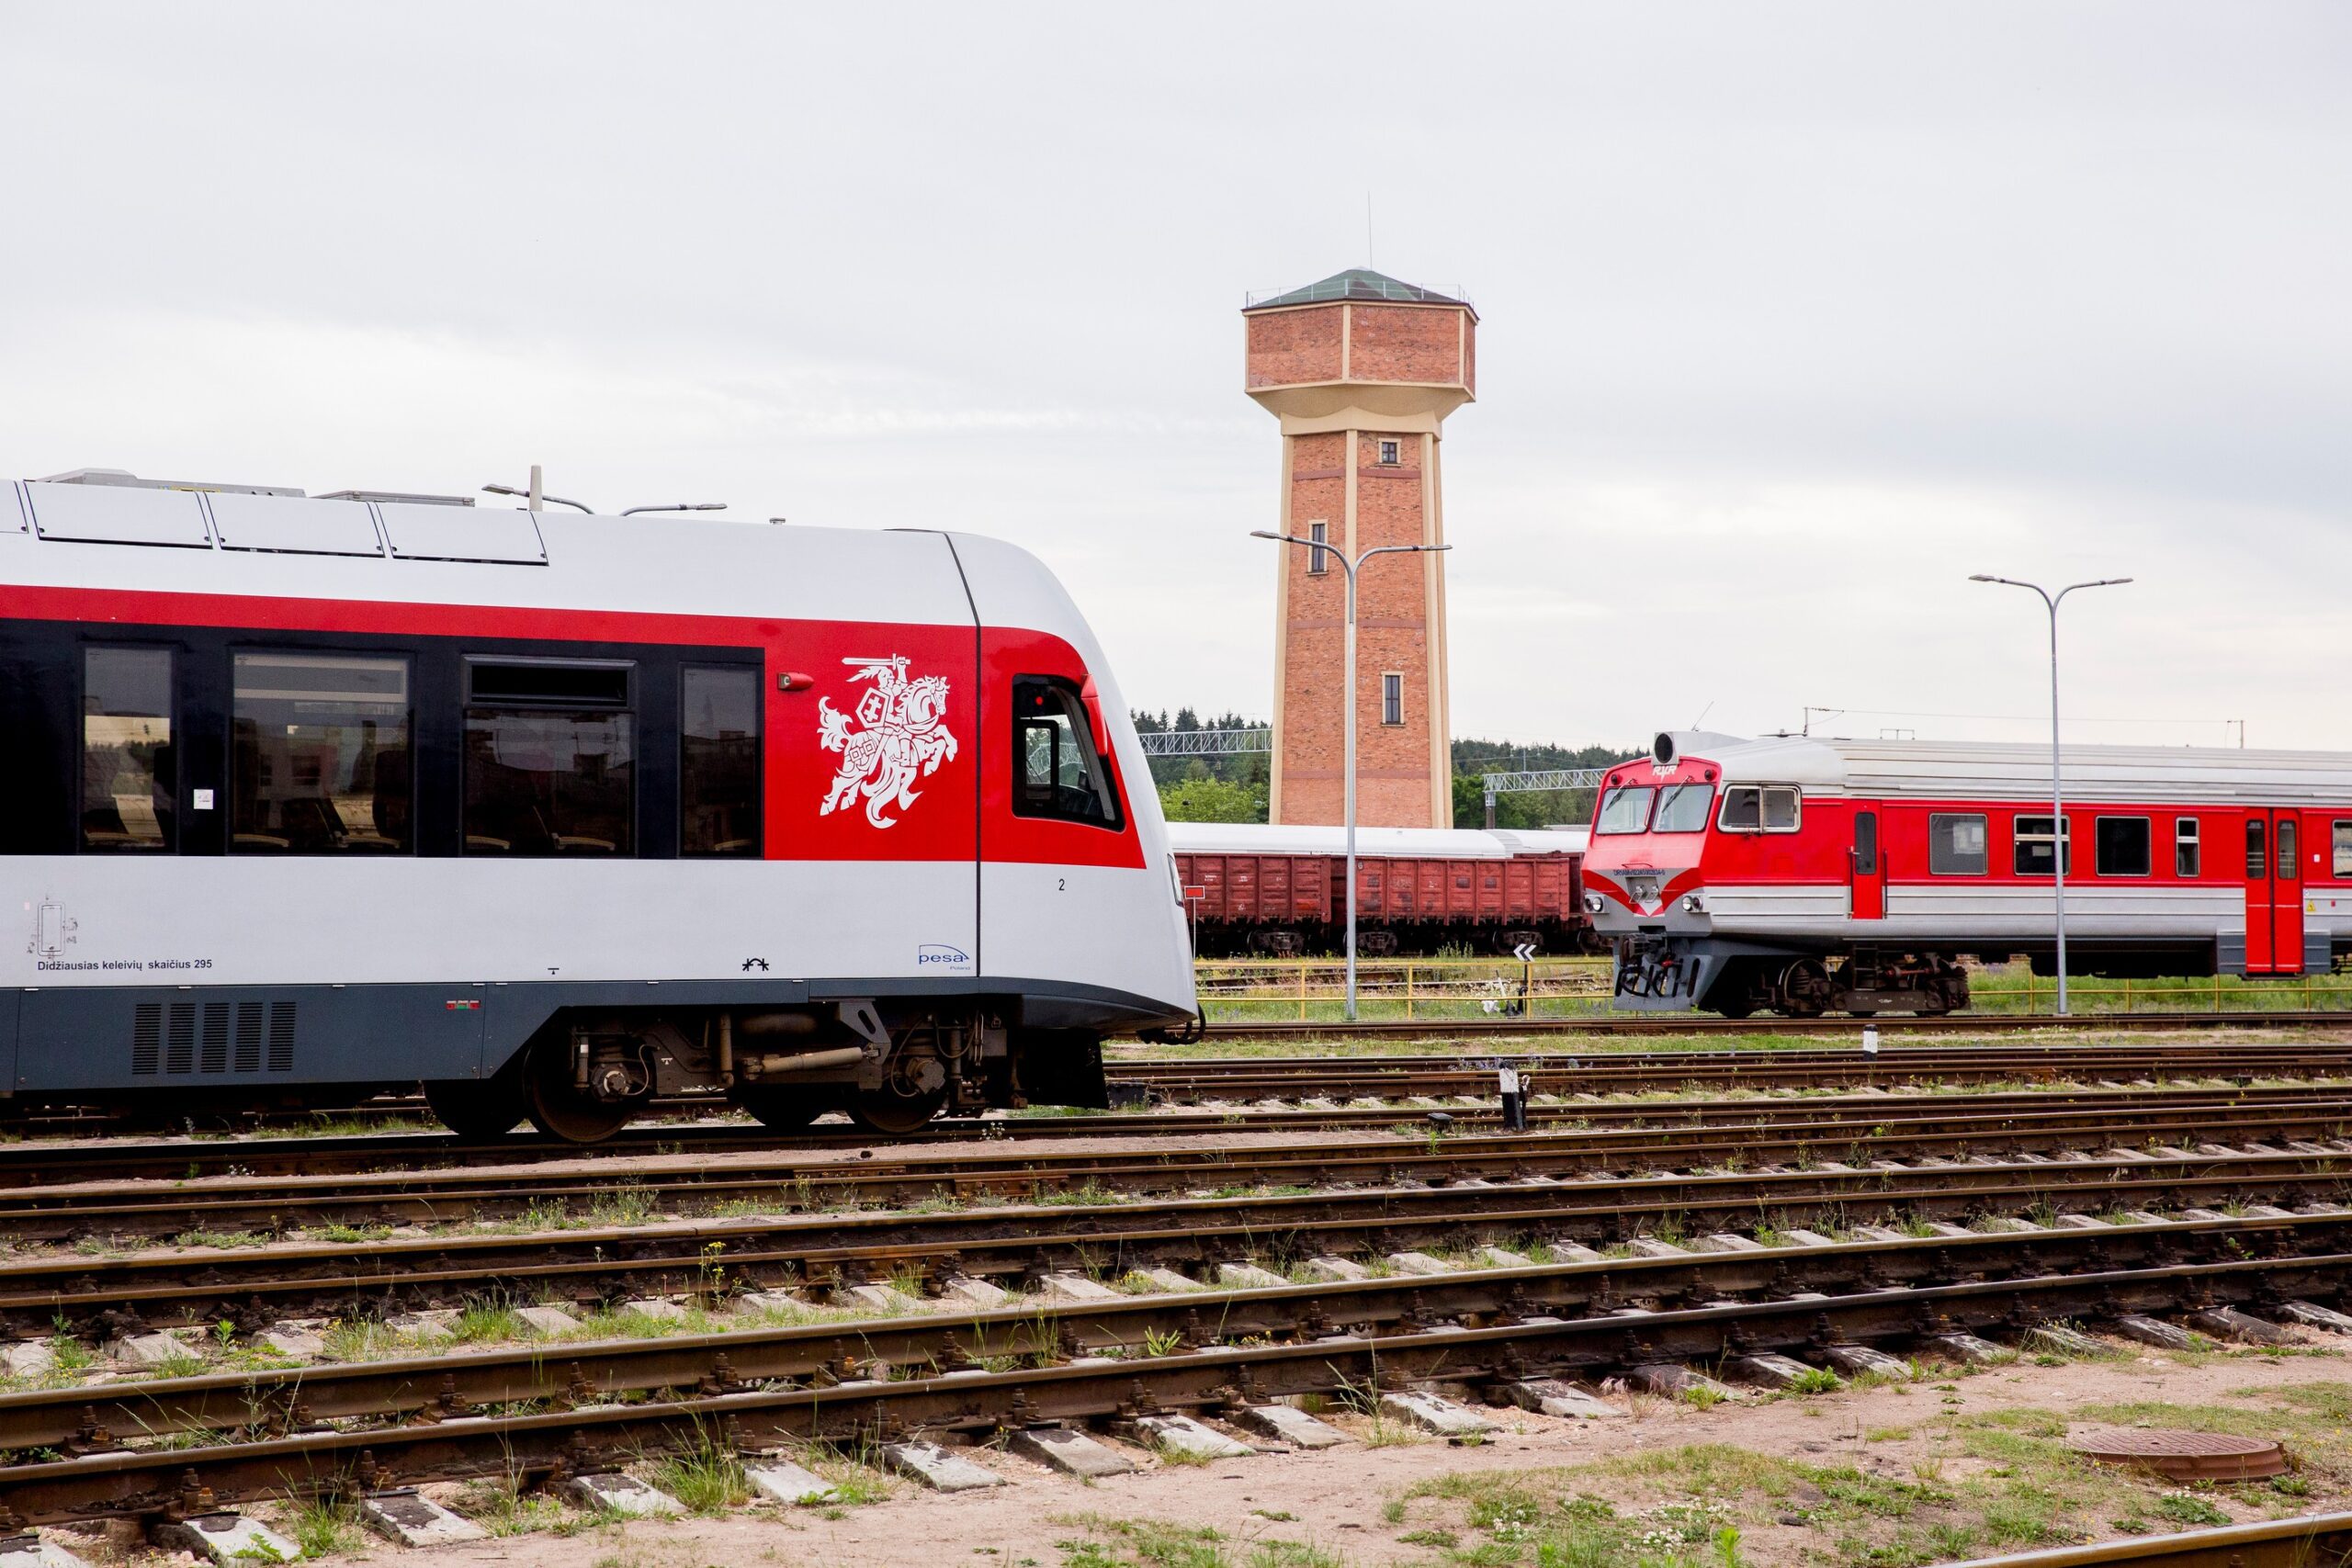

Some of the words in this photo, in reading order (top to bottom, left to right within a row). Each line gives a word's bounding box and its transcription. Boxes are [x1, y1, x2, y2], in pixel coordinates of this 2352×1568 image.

[1058, 878, 1065, 891] 2
[38, 961, 99, 971] Didžiausias
[102, 960, 142, 972] keleivių
[148, 959, 191, 970] skaičius
[194, 959, 212, 969] 295
